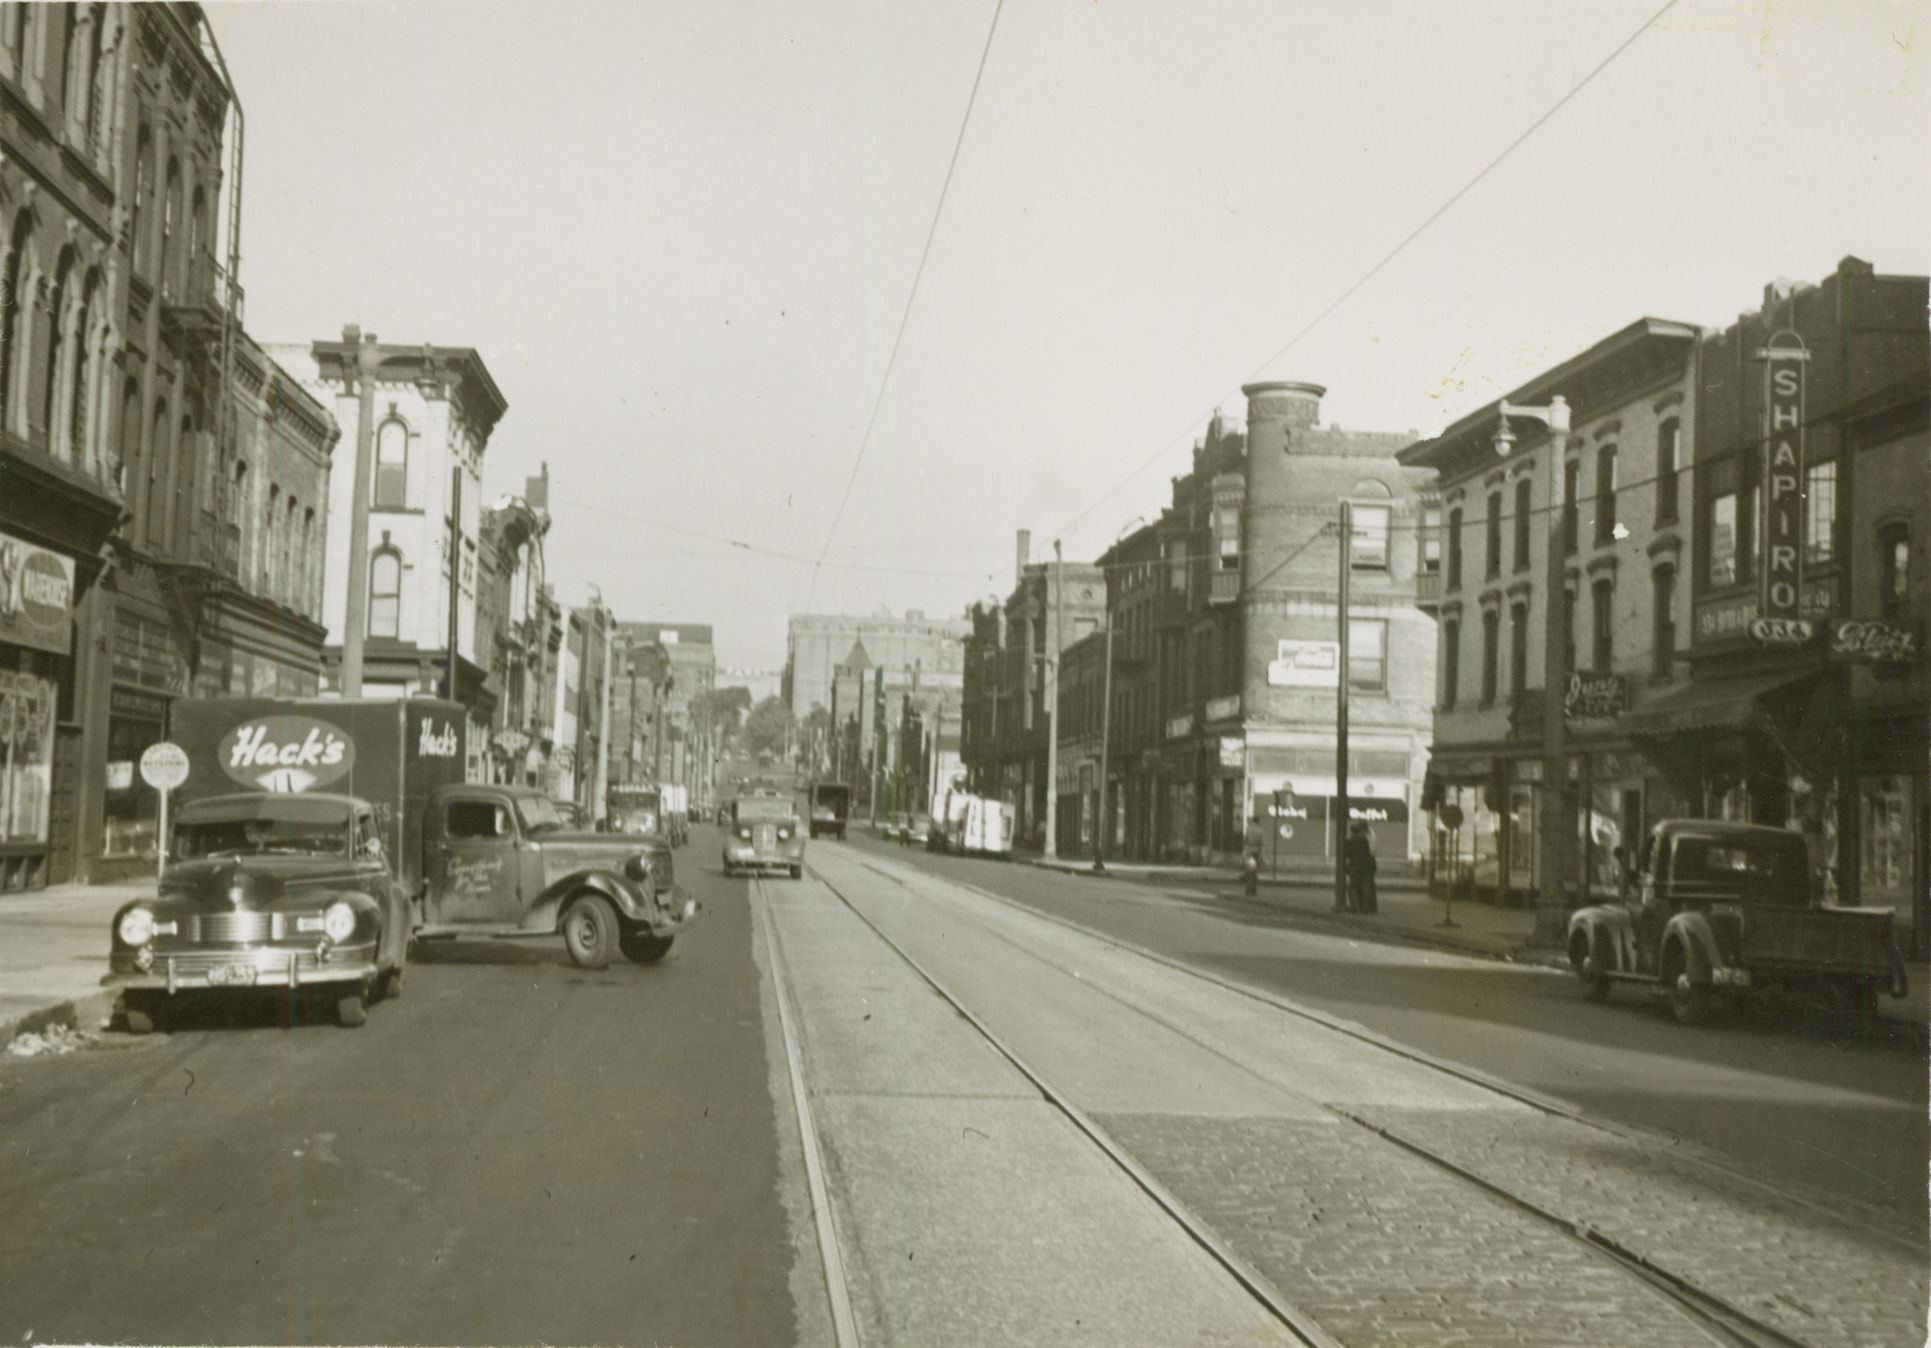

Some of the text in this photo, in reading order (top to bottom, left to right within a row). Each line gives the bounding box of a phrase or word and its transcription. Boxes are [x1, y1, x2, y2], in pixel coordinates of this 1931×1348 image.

[1770, 368, 1799, 610] SHAPIRO
[229, 725, 346, 768] Hack's
[418, 716, 458, 757] Hack's
